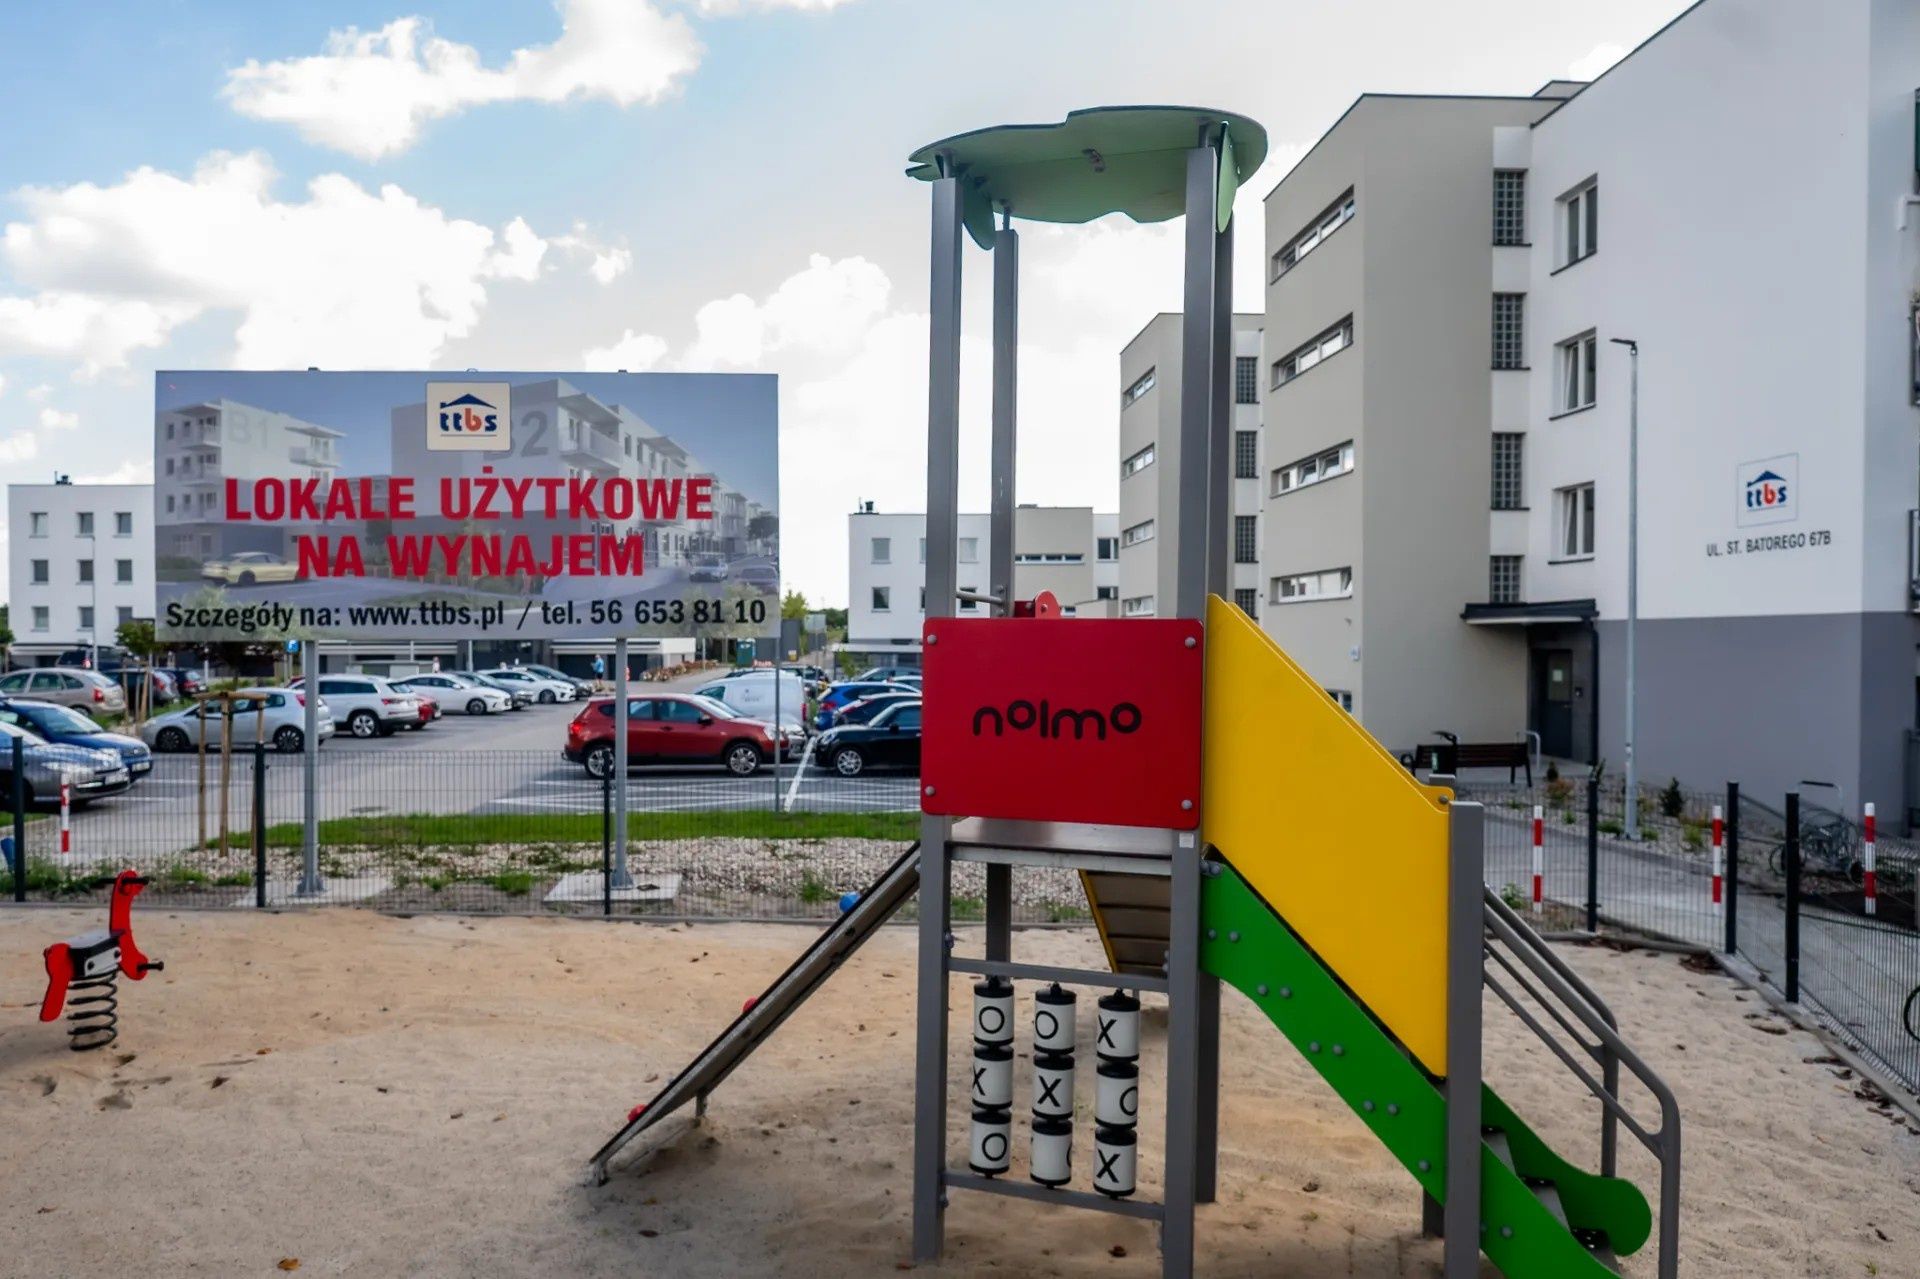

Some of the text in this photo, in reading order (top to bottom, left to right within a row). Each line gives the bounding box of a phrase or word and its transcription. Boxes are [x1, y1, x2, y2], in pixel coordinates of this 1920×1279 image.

[440, 408, 495, 431] ttbs
[224, 466, 713, 521] LOKALE UŻYTKOWE
[1746, 483, 1788, 508] ttbs
[298, 534, 644, 578] NA WYNAJEM
[1706, 530, 1832, 557] UL. ST. BATOREGO 67B
[166, 600, 294, 633] Szczegóły
[300, 606, 342, 627] na:
[349, 600, 505, 630] www.ttbs.pl
[541, 601, 582, 625] tel.
[590, 600, 623, 624] 56
[634, 600, 685, 625] 653
[693, 600, 726, 624] 81
[734, 600, 766, 624] 10
[972, 699, 1142, 741] nolmo
